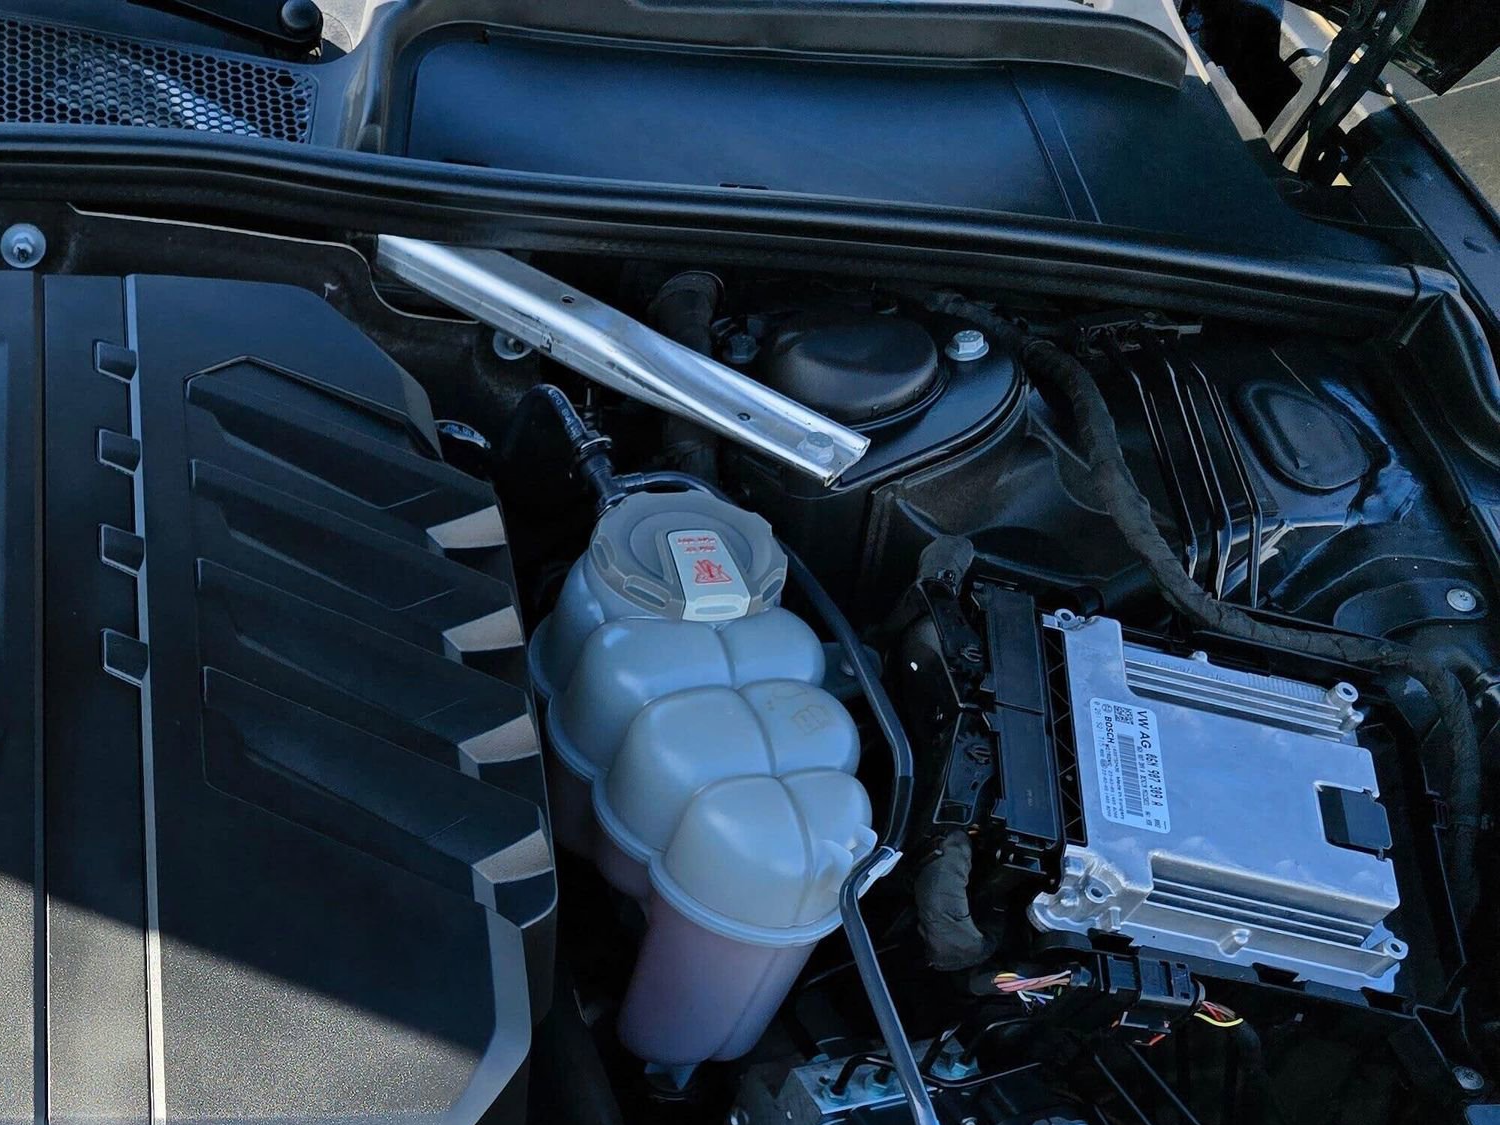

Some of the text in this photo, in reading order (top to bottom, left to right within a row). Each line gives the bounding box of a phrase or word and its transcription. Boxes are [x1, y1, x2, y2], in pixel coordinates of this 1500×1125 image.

[1104, 716, 1115, 744] BOSCH
[1137, 710, 1149, 730] VW
[1140, 731, 1152, 749] AG
